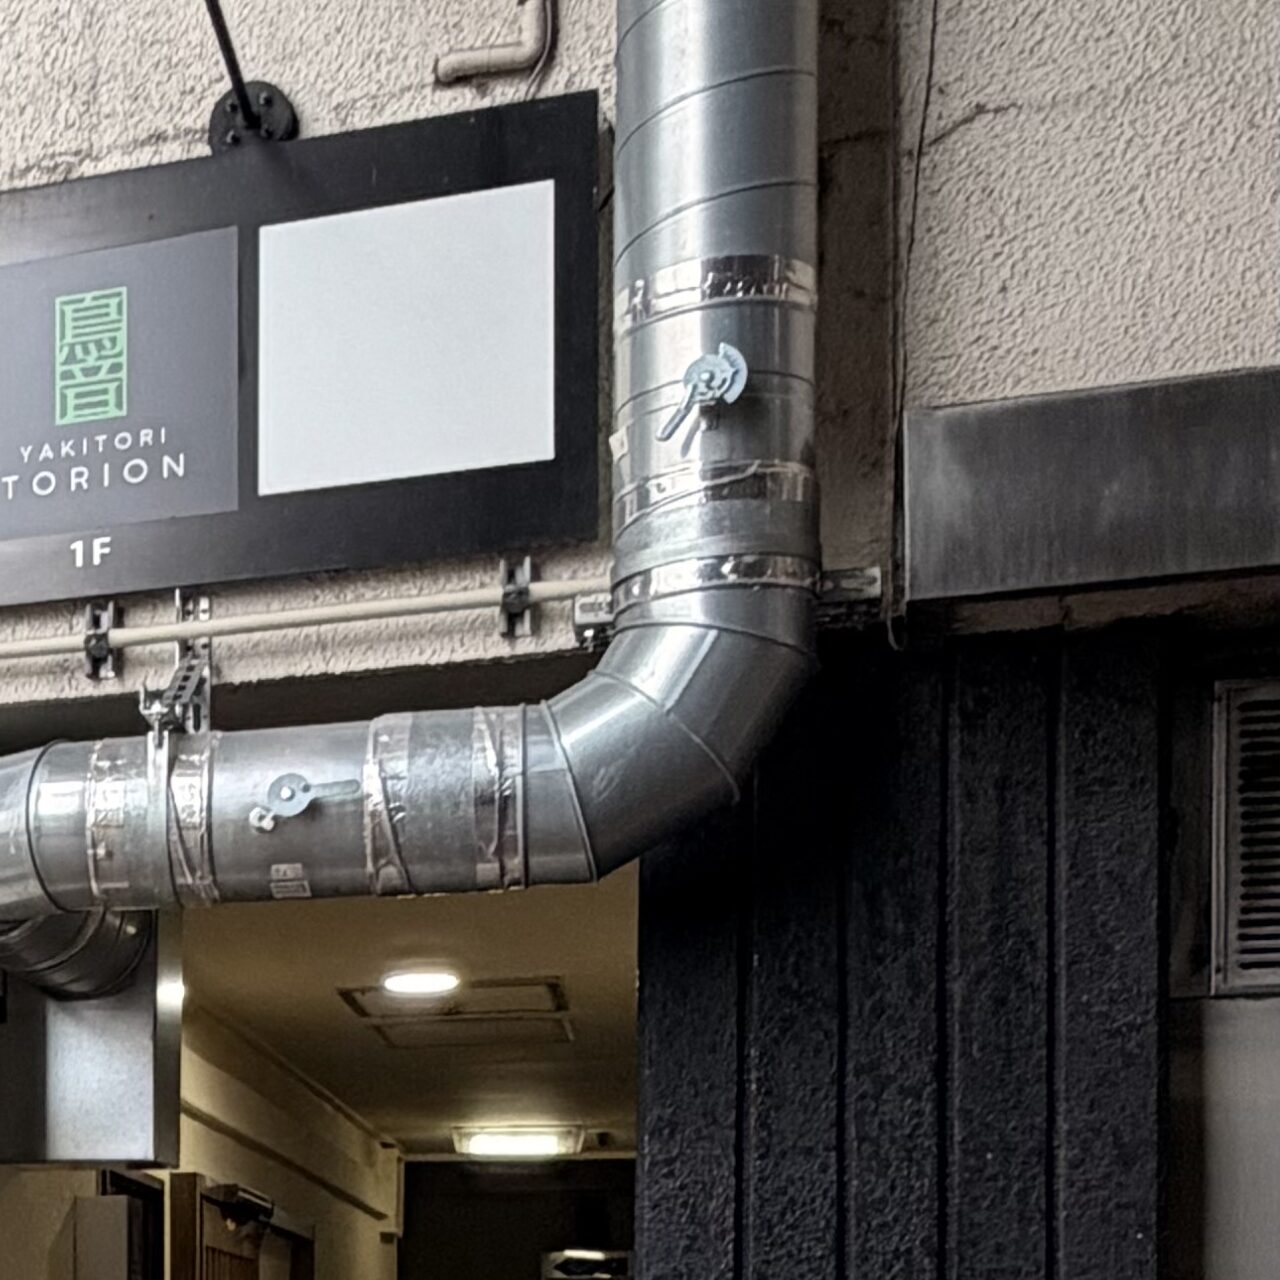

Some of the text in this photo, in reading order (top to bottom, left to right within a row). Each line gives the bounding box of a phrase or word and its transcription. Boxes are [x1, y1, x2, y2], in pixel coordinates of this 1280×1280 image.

[20, 427, 166, 463] YAKITORI
[1, 453, 185, 500] TORION
[70, 536, 112, 567] 1F
